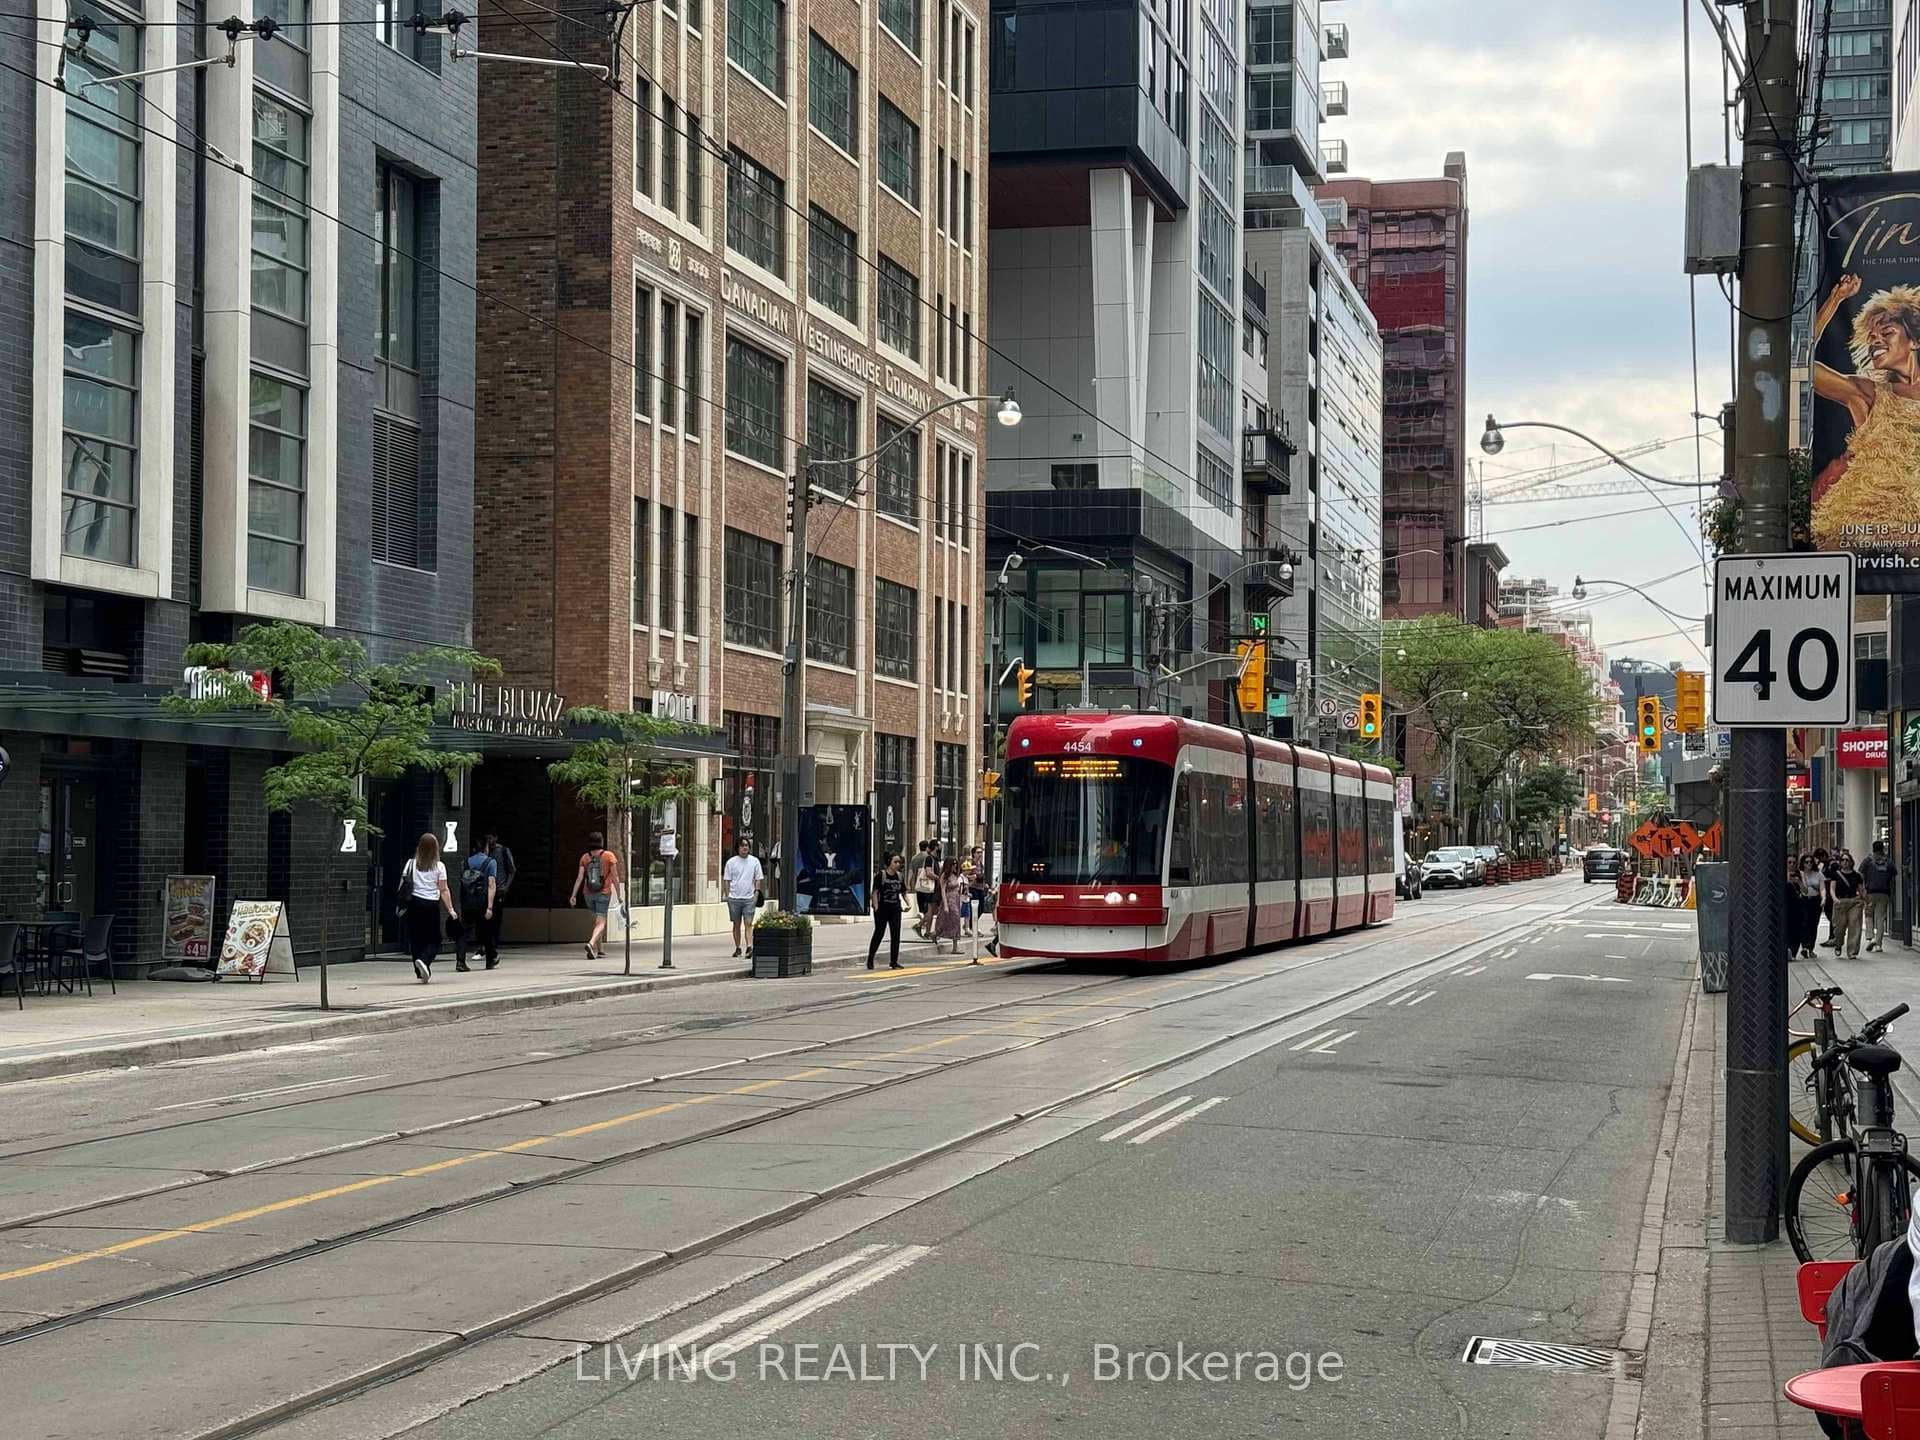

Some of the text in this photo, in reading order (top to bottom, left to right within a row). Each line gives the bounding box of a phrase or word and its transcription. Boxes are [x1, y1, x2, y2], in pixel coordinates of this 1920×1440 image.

[1861, 257, 1877, 265] THE
[1880, 257, 1897, 265] TINA
[720, 267, 932, 412] CANADIAN WESTINGHOUSE COMPANY
[1840, 523, 1873, 535] JUNE
[1876, 523, 1889, 535] 18
[1873, 540, 1909, 549] MIRVISH
[1725, 574, 1840, 601] MAXIMUM
[1723, 627, 1840, 702] 40
[1063, 741, 1092, 752] 4454
[824, 852, 837, 868] Y
